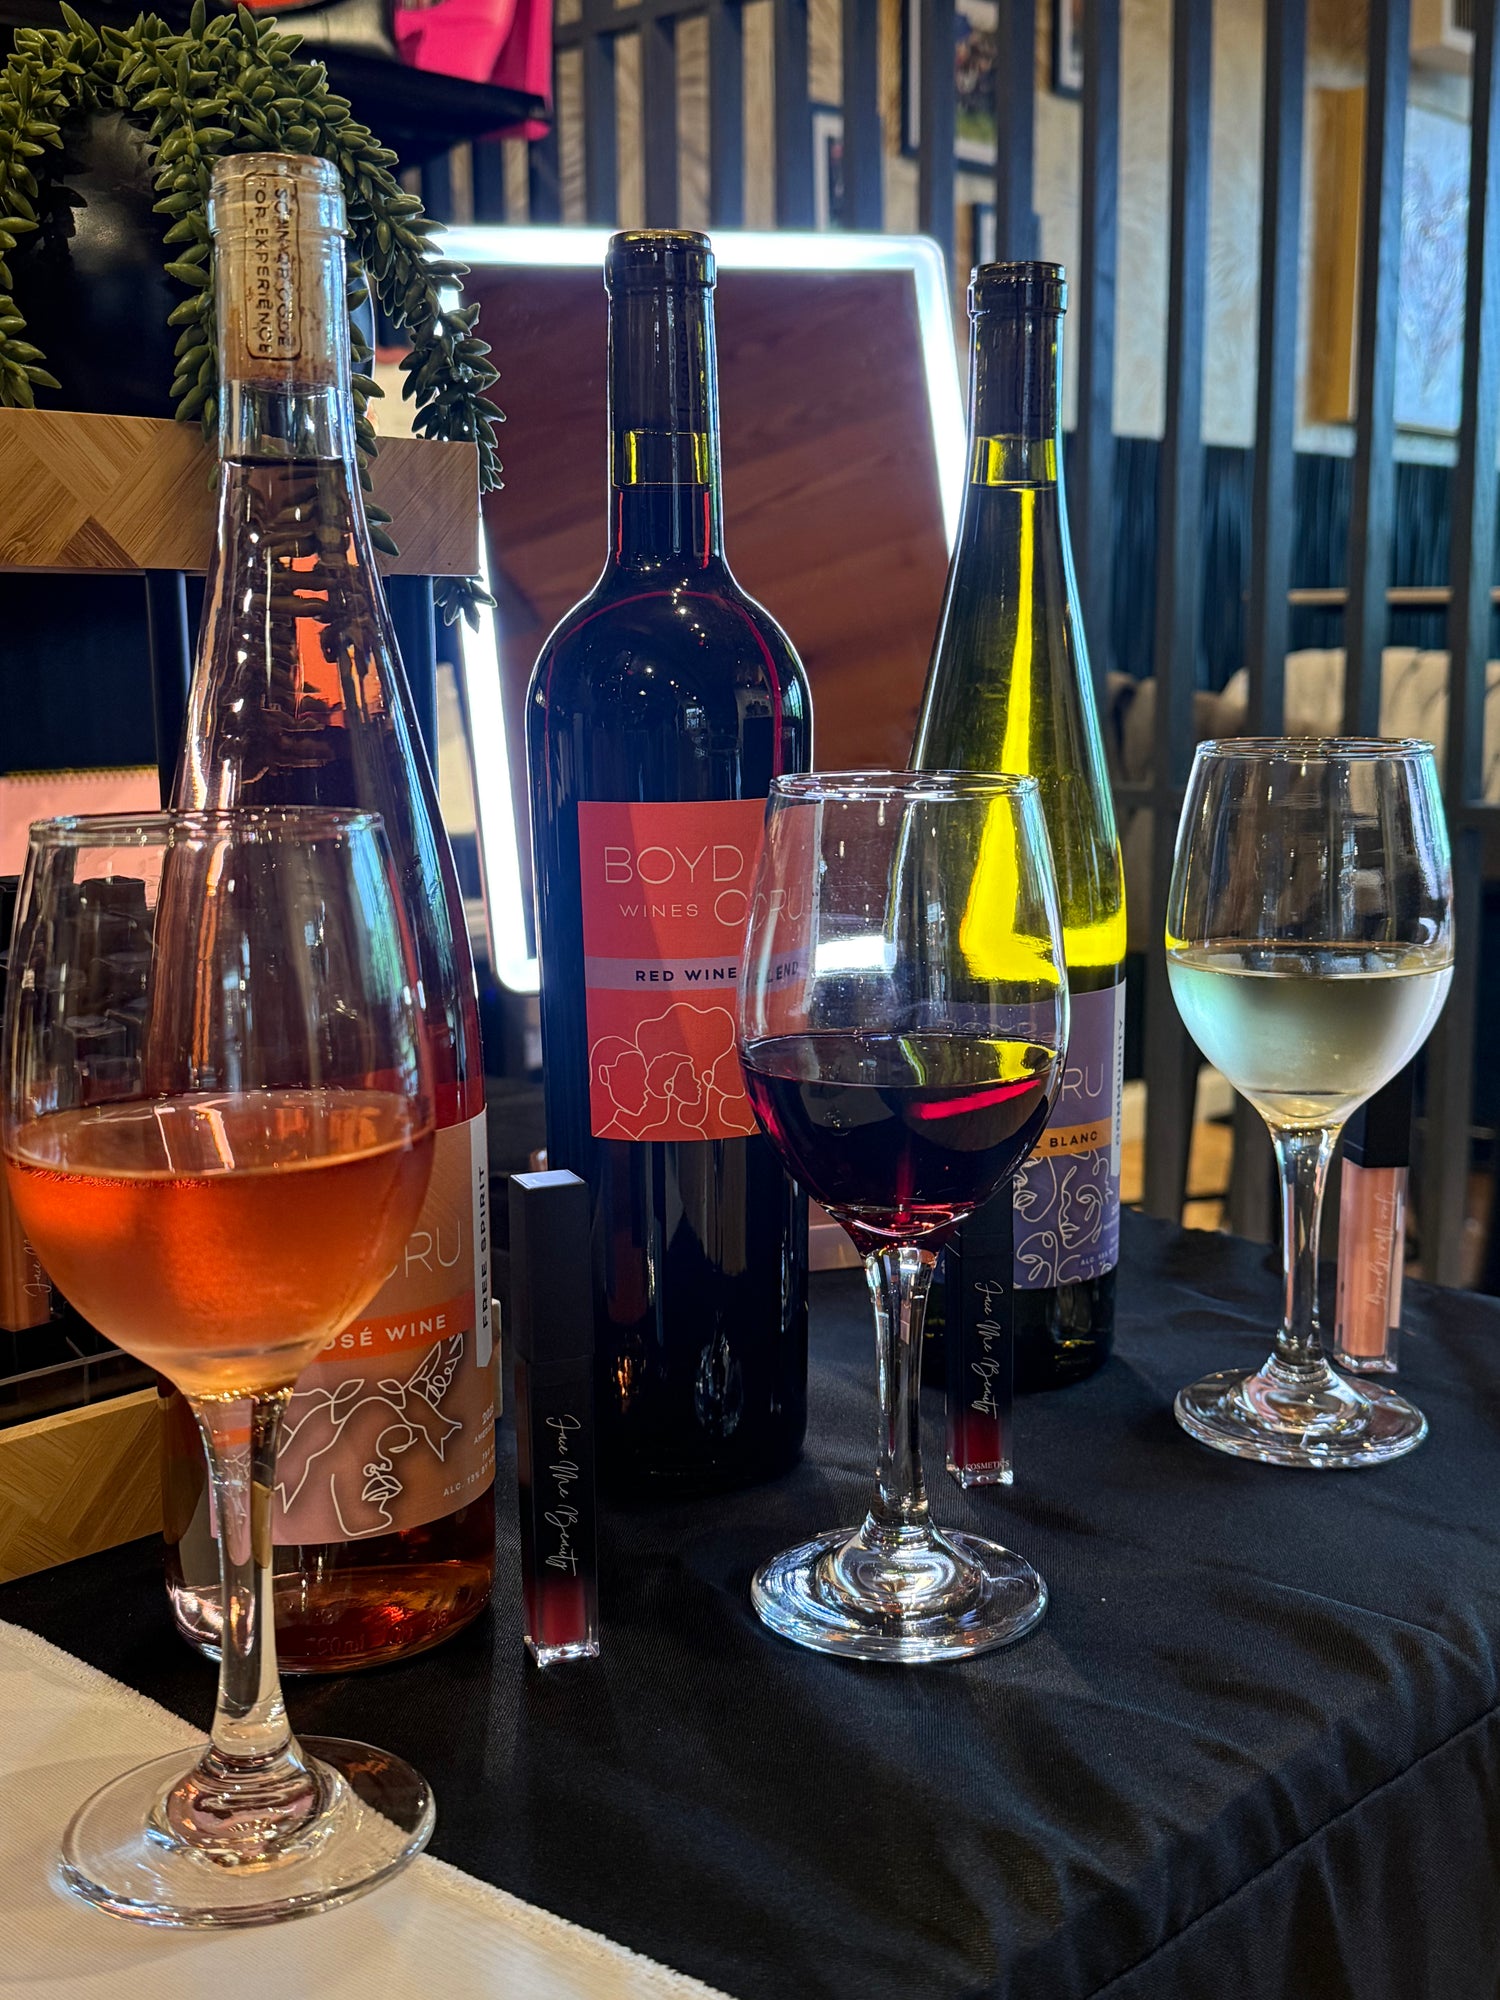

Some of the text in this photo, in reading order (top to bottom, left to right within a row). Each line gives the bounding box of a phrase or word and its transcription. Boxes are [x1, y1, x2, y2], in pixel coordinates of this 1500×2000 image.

[255, 228, 271, 354] EXPERIENCE
[276, 286, 291, 347] CODE
[604, 845, 744, 885] BOYD
[620, 903, 698, 918] WINES
[635, 968, 679, 983] RED
[684, 965, 737, 982] WINE
[1061, 1064, 1104, 1101] RU
[1115, 1019, 1124, 1147] COMMUNITY
[1049, 1131, 1098, 1149] BLANC
[479, 1165, 489, 1329] FREE SPIRIT
[322, 1314, 447, 1351] OSÉ WINE
[971, 1357, 1000, 1420] Beauty
[965, 1458, 1010, 1472] COSMETICS
[544, 1504, 579, 1577] Beauty
